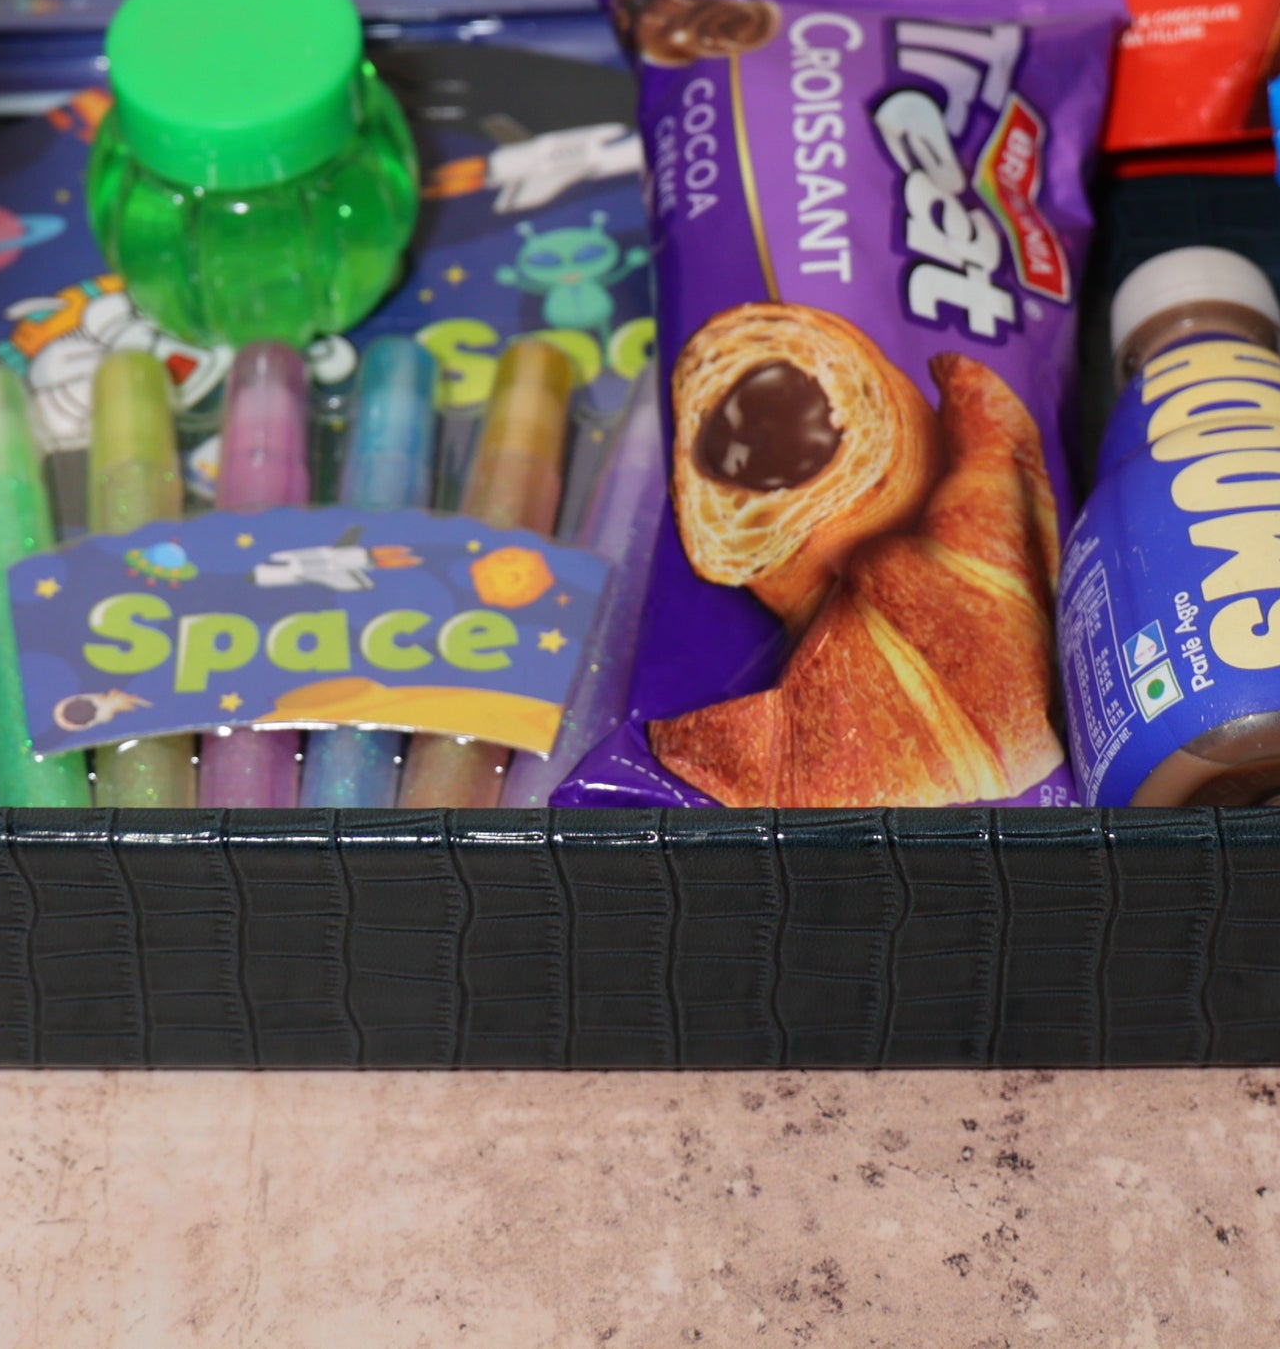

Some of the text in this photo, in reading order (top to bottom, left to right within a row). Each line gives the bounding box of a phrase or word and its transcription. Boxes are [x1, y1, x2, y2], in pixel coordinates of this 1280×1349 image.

[682, 78, 719, 220] COCOA
[788, 11, 863, 284] CROISSANT
[873, 18, 1024, 338] Treat
[83, 593, 519, 693] Space
[1174, 591, 1199, 634] Agro
